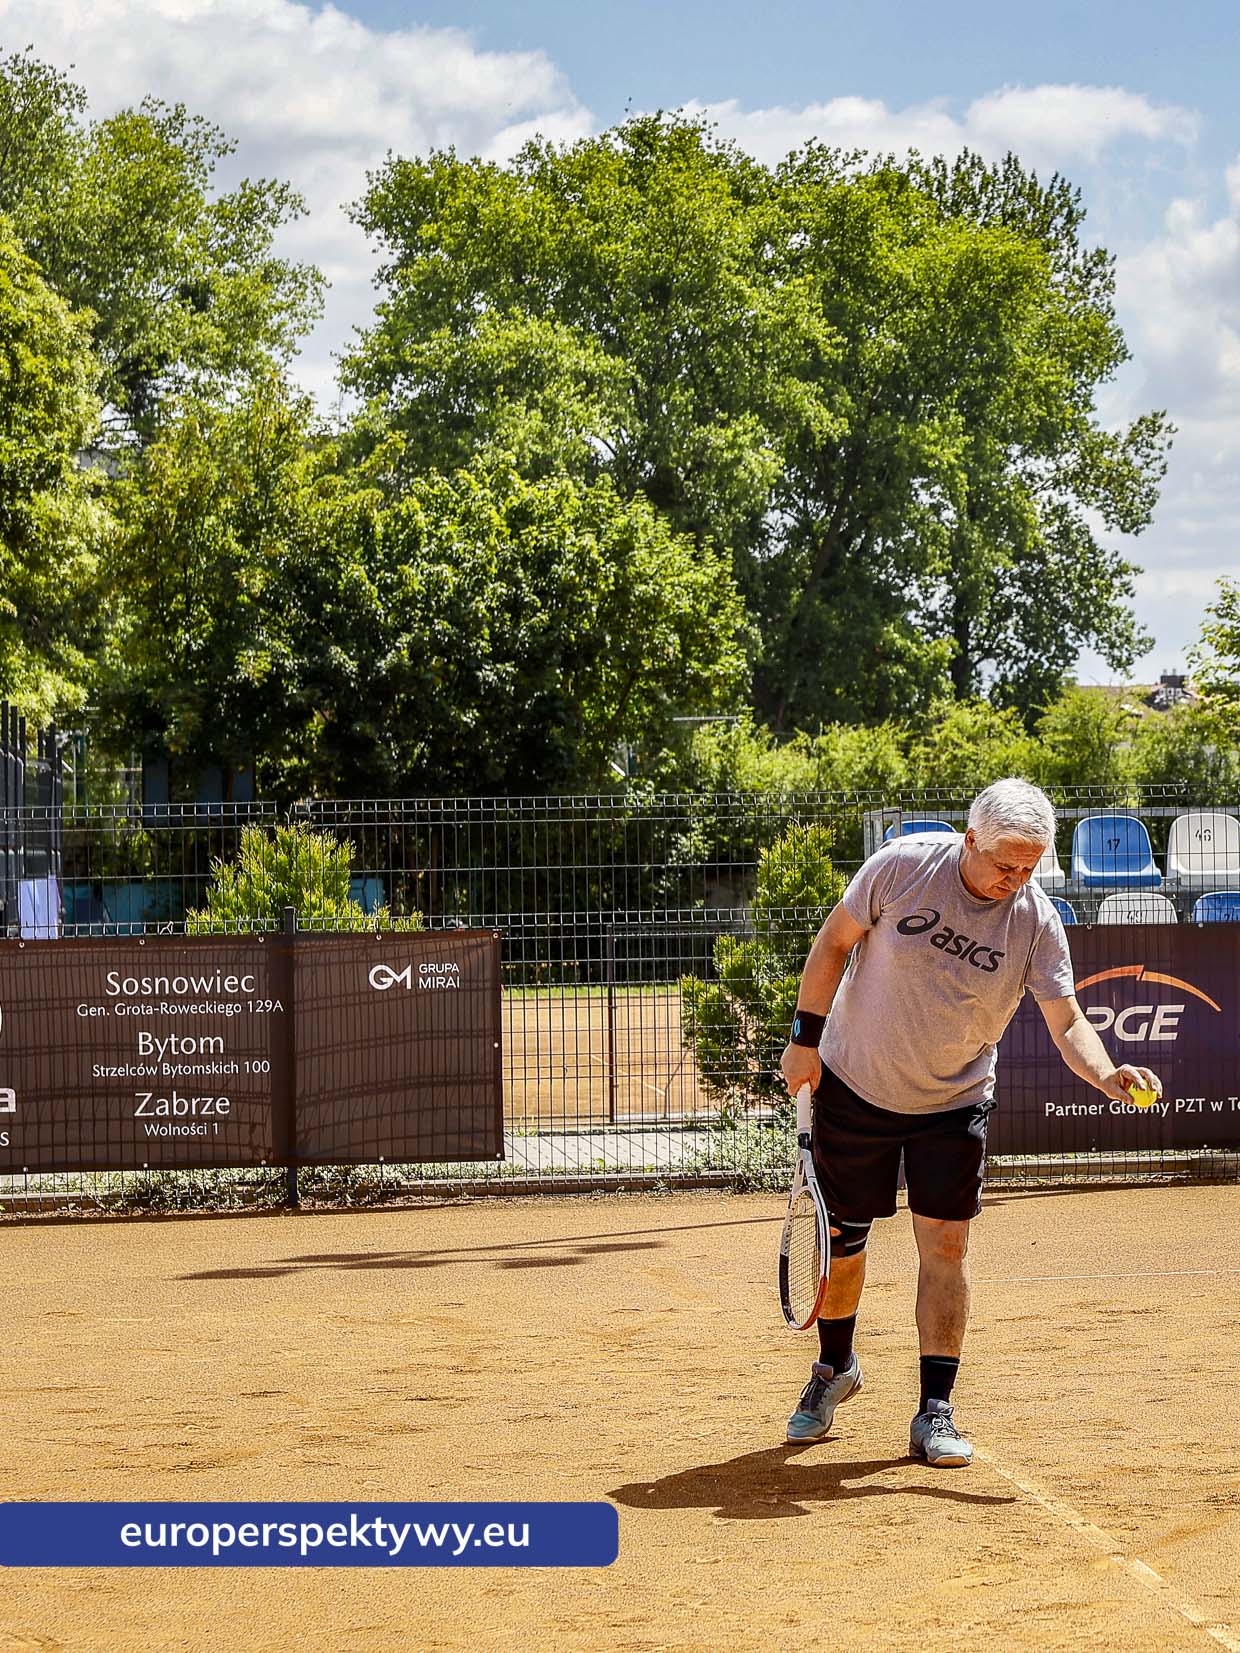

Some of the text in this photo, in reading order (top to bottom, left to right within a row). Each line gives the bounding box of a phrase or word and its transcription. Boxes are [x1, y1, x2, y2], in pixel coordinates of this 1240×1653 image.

[1107, 838, 1120, 851] 17
[929, 925, 1006, 973] asics
[419, 964, 459, 973] GRUPA
[106, 970, 254, 995] Sosnowiec
[419, 976, 459, 988] MIRAI
[77, 1000, 283, 1017] Gen. Grota-Roweckiego 129A
[1086, 1005, 1184, 1041] PGE
[139, 1032, 223, 1062] Bytom
[93, 1061, 269, 1078] Strzelców Bytomskich 100
[135, 1091, 229, 1116] Zabrze
[1046, 1103, 1104, 1116] Partner
[1176, 1098, 1205, 1112] PZT
[1211, 1101, 1223, 1111] w
[145, 1122, 219, 1136] Wolności 1
